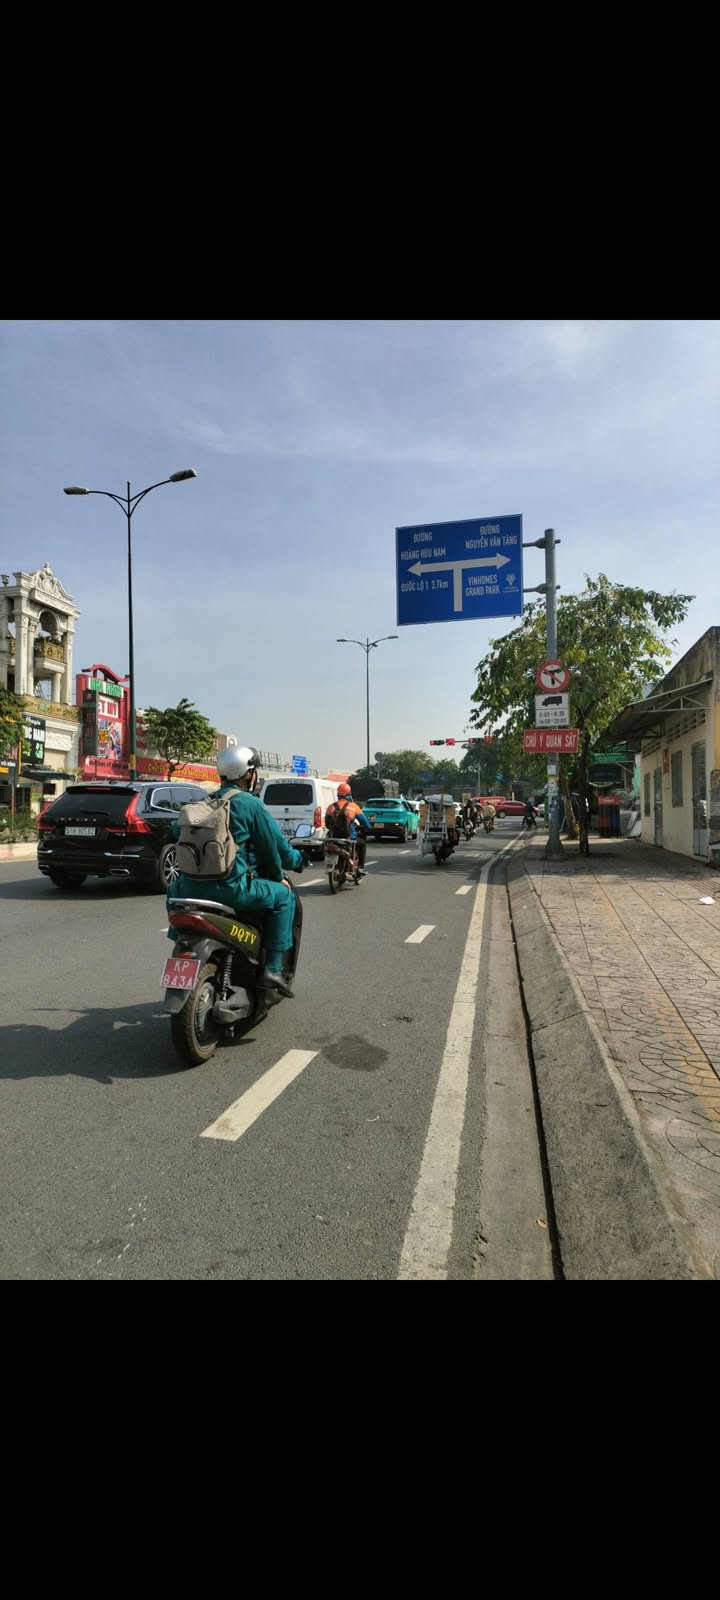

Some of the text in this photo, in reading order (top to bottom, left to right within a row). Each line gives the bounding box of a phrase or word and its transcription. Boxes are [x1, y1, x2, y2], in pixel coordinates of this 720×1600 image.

[480, 523, 500, 535] ĐƯỜNG
[413, 531, 432, 543] ĐƯỜNG
[465, 536, 489, 549] NGUYỄN
[489, 535, 501, 547] VĂN
[400, 548, 420, 560] HOÀNG
[433, 547, 446, 557] NAM
[401, 579, 416, 592] QUỐC
[417, 579, 424, 592] LỘ
[468, 574, 497, 586] VINHOMES
[465, 586, 485, 597] GRAND
[485, 585, 500, 595] PARK
[525, 733, 537, 748] CHÚ
[546, 734, 562, 748] QUAN
[564, 732, 576, 747] SÁT
[230, 924, 257, 945] DQTV
[174, 960, 190, 972] KP
[162, 974, 193, 988] 843A
